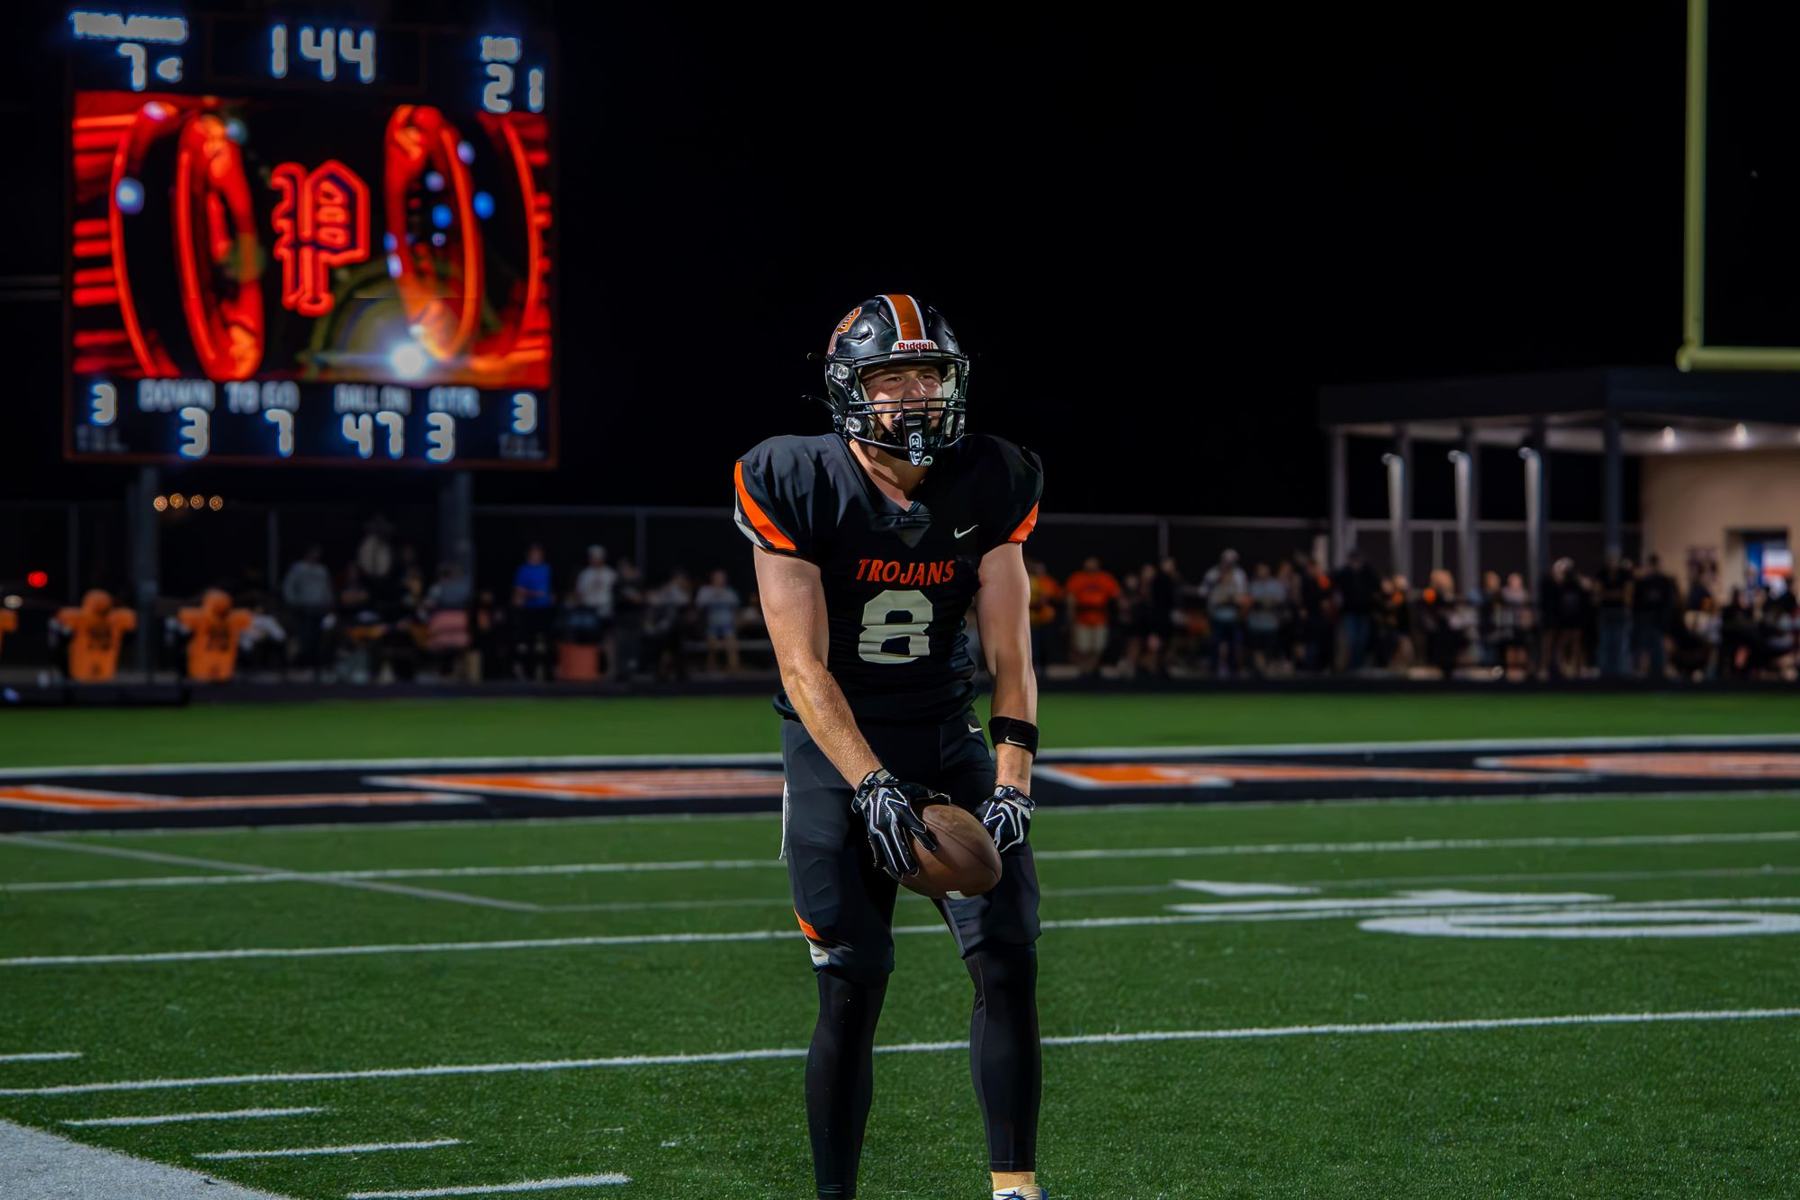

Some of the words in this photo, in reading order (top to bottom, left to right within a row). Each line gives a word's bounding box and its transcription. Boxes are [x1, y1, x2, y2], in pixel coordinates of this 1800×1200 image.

[117, 43, 147, 91] 7
[483, 63, 544, 113] 21
[271, 159, 371, 317] P
[897, 341, 934, 351] Riddell
[92, 383, 117, 425] 3
[512, 393, 538, 434] 3
[179, 407, 210, 458] 3
[264, 409, 294, 457] 7
[342, 411, 404, 459] 47
[426, 412, 456, 463] 3
[856, 559, 956, 586] TROJANS
[858, 590, 934, 664] 8
